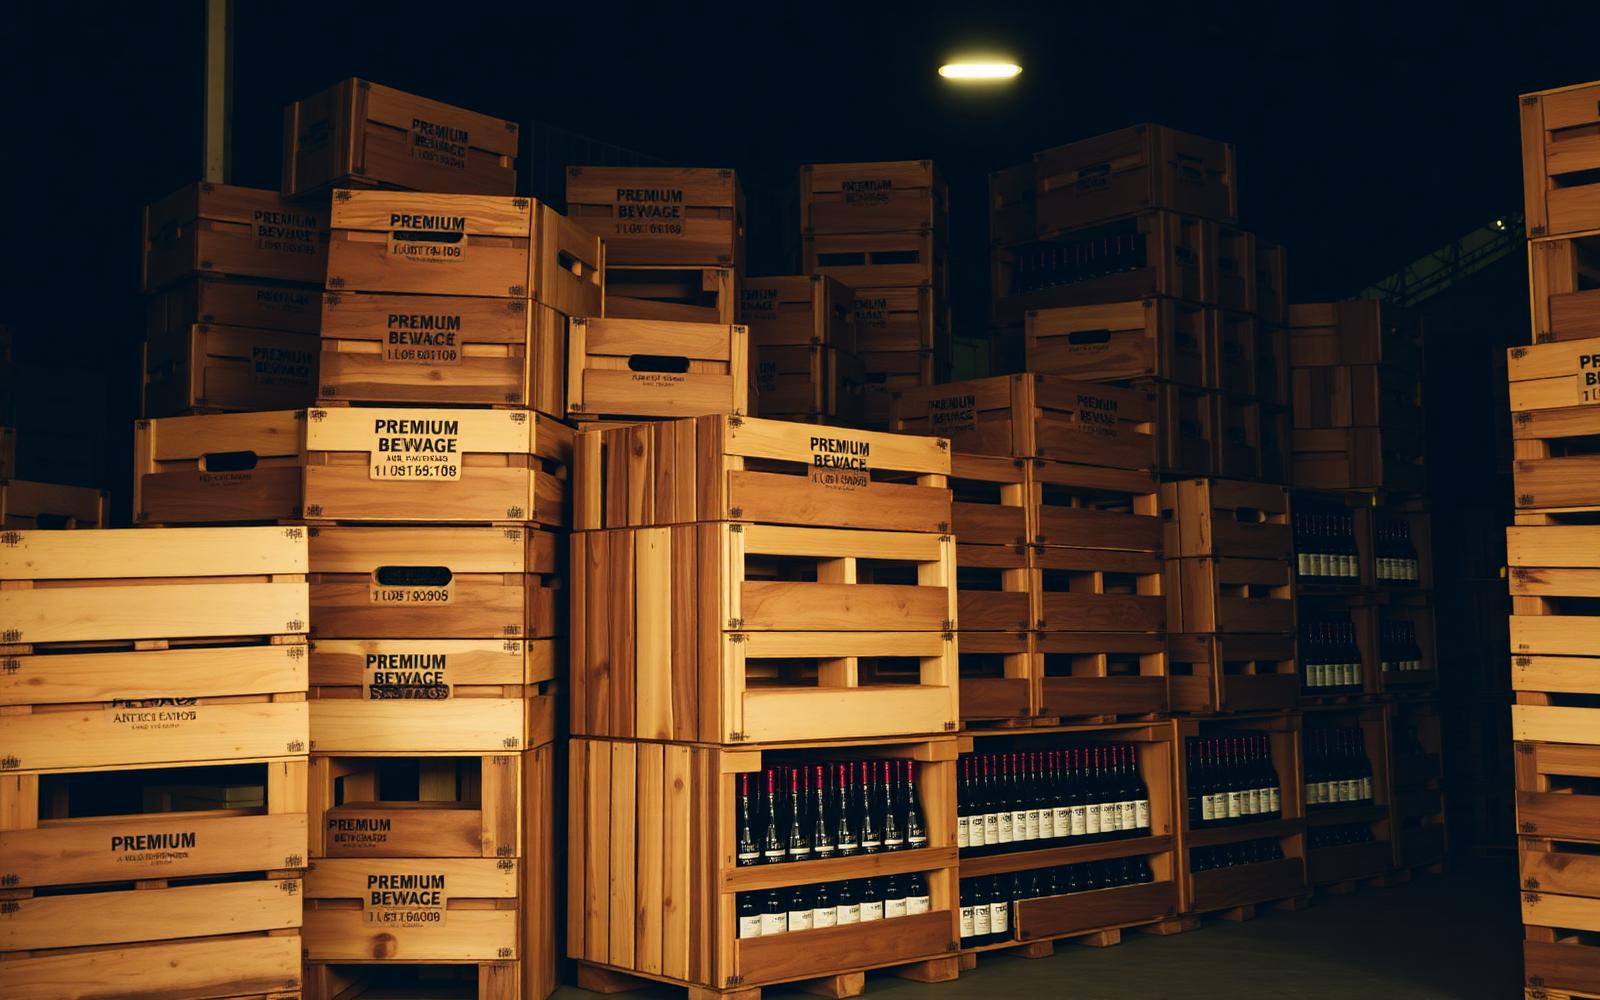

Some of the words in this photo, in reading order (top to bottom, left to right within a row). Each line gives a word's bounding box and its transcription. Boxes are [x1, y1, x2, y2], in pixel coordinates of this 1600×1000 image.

[616, 189, 682, 202] PREMIUM
[391, 213, 465, 231] PREMIUM
[375, 419, 458, 435] PREMIUM
[810, 436, 870, 457] PREMIUM
[366, 654, 446, 669] PREMIUM
[111, 832, 196, 851] PREMIUM
[367, 875, 445, 889] PREMIUM
